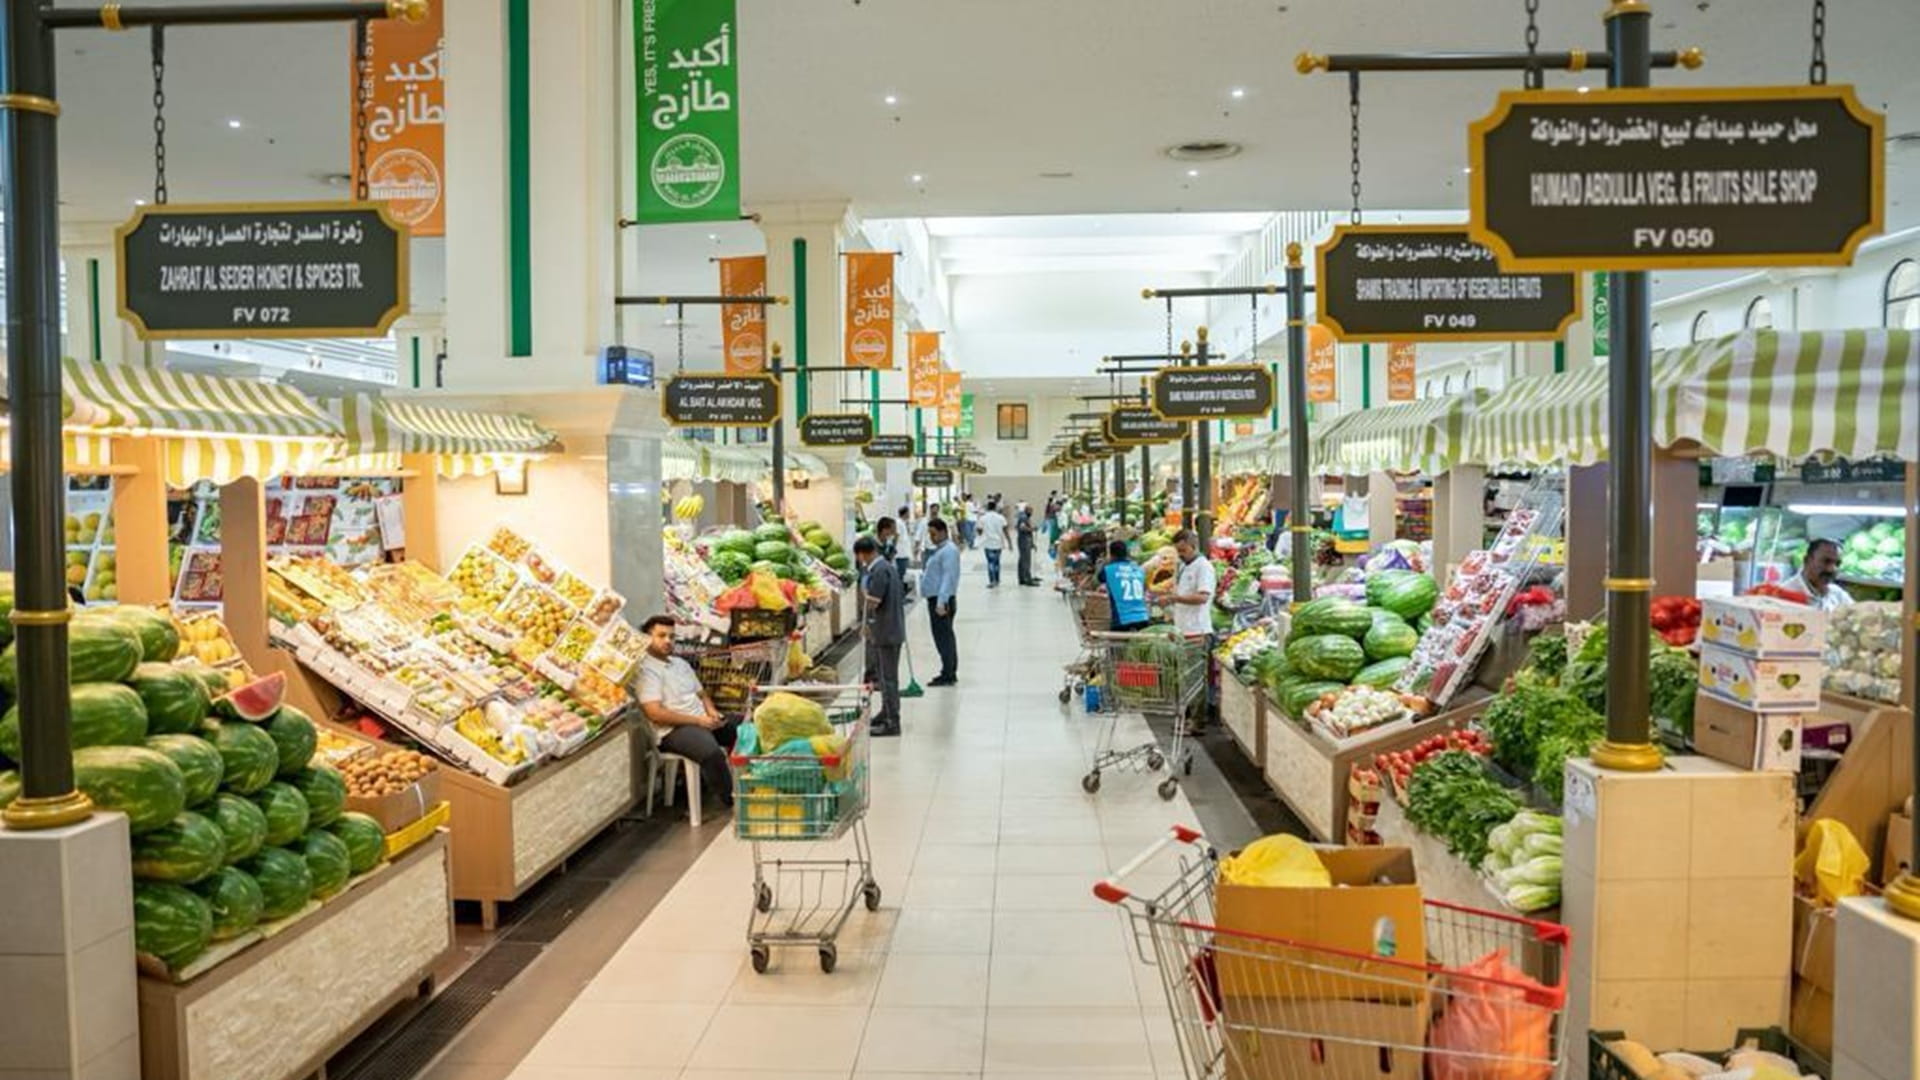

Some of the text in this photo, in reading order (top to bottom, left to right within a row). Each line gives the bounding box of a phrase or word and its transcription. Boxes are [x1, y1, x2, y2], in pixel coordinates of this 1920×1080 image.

[667, 22, 730, 77] أكيد
[385, 37, 448, 91] أكيد
[369, 92, 448, 142] طازج
[652, 79, 730, 130] طازج
[1589, 118, 1658, 147] الخضروات
[1661, 120, 1691, 148] لبيع
[1694, 114, 1745, 144] عبدالله
[1748, 121, 1785, 144] حميد
[1787, 118, 1817, 143] محل
[1530, 170, 1818, 205] HUMAID ABDULLA VEG. & FRUITS SALE SHOP
[159, 221, 363, 247] زهرة السدر لتجارة العسل والبهارات
[1634, 228, 1714, 247] FV 050
[1396, 243, 1443, 262] الخضروات
[160, 263, 364, 291] ZAHRAT AL SEDER HONEY & SPICES TR.
[233, 307, 290, 322] FV 072
[853, 304, 891, 327] طازج
[1424, 314, 1476, 328] FV 049
[679, 397, 688, 407] AL
[1121, 579, 1144, 600] 20
